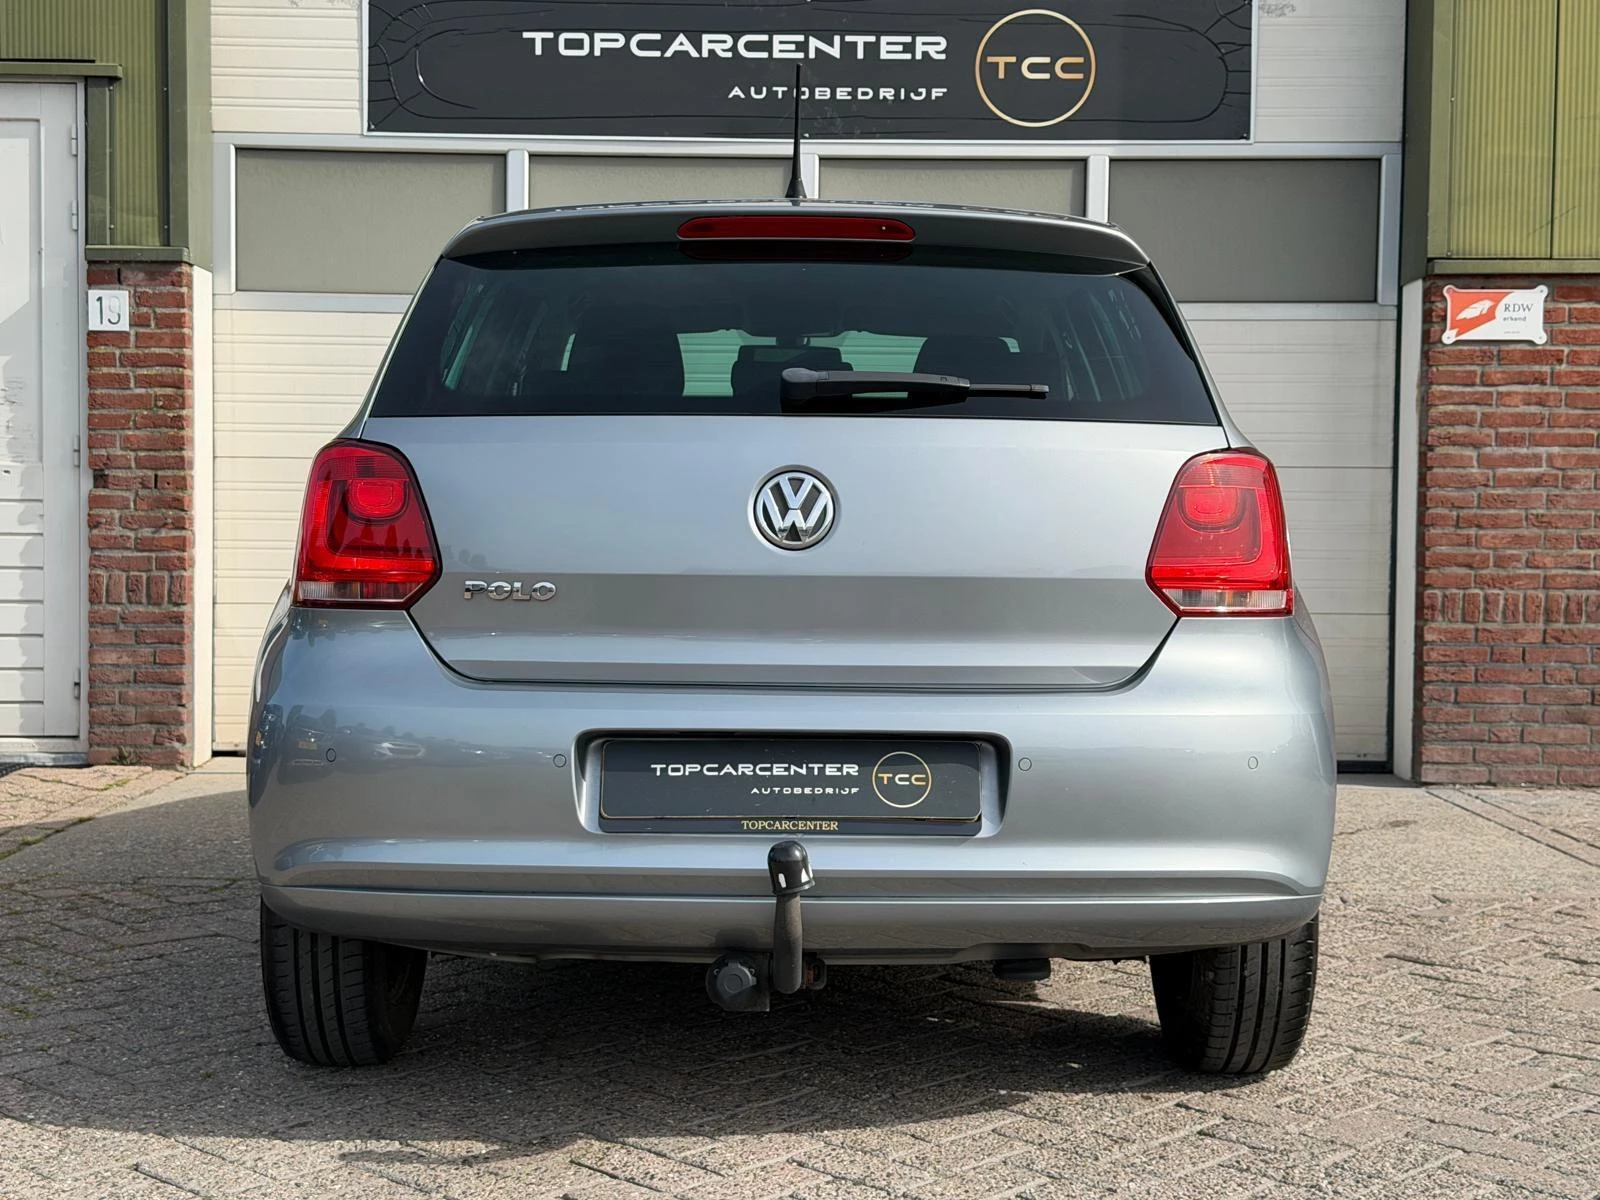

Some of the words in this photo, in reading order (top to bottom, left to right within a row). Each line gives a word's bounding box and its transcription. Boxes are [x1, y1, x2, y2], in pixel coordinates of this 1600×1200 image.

[522, 31, 948, 60] TOPCARCENTER
[986, 56, 1086, 80] TCC
[728, 86, 948, 101] AUTOBEDRIJF
[95, 295, 121, 325] 19
[1503, 303, 1534, 313] RDW
[464, 580, 557, 601] POLO
[650, 763, 860, 777] TOPCARCENTER
[877, 773, 927, 786] TCC
[750, 786, 860, 795] AUTOBEDRIJF
[740, 820, 839, 831] TOPCARCENTER
